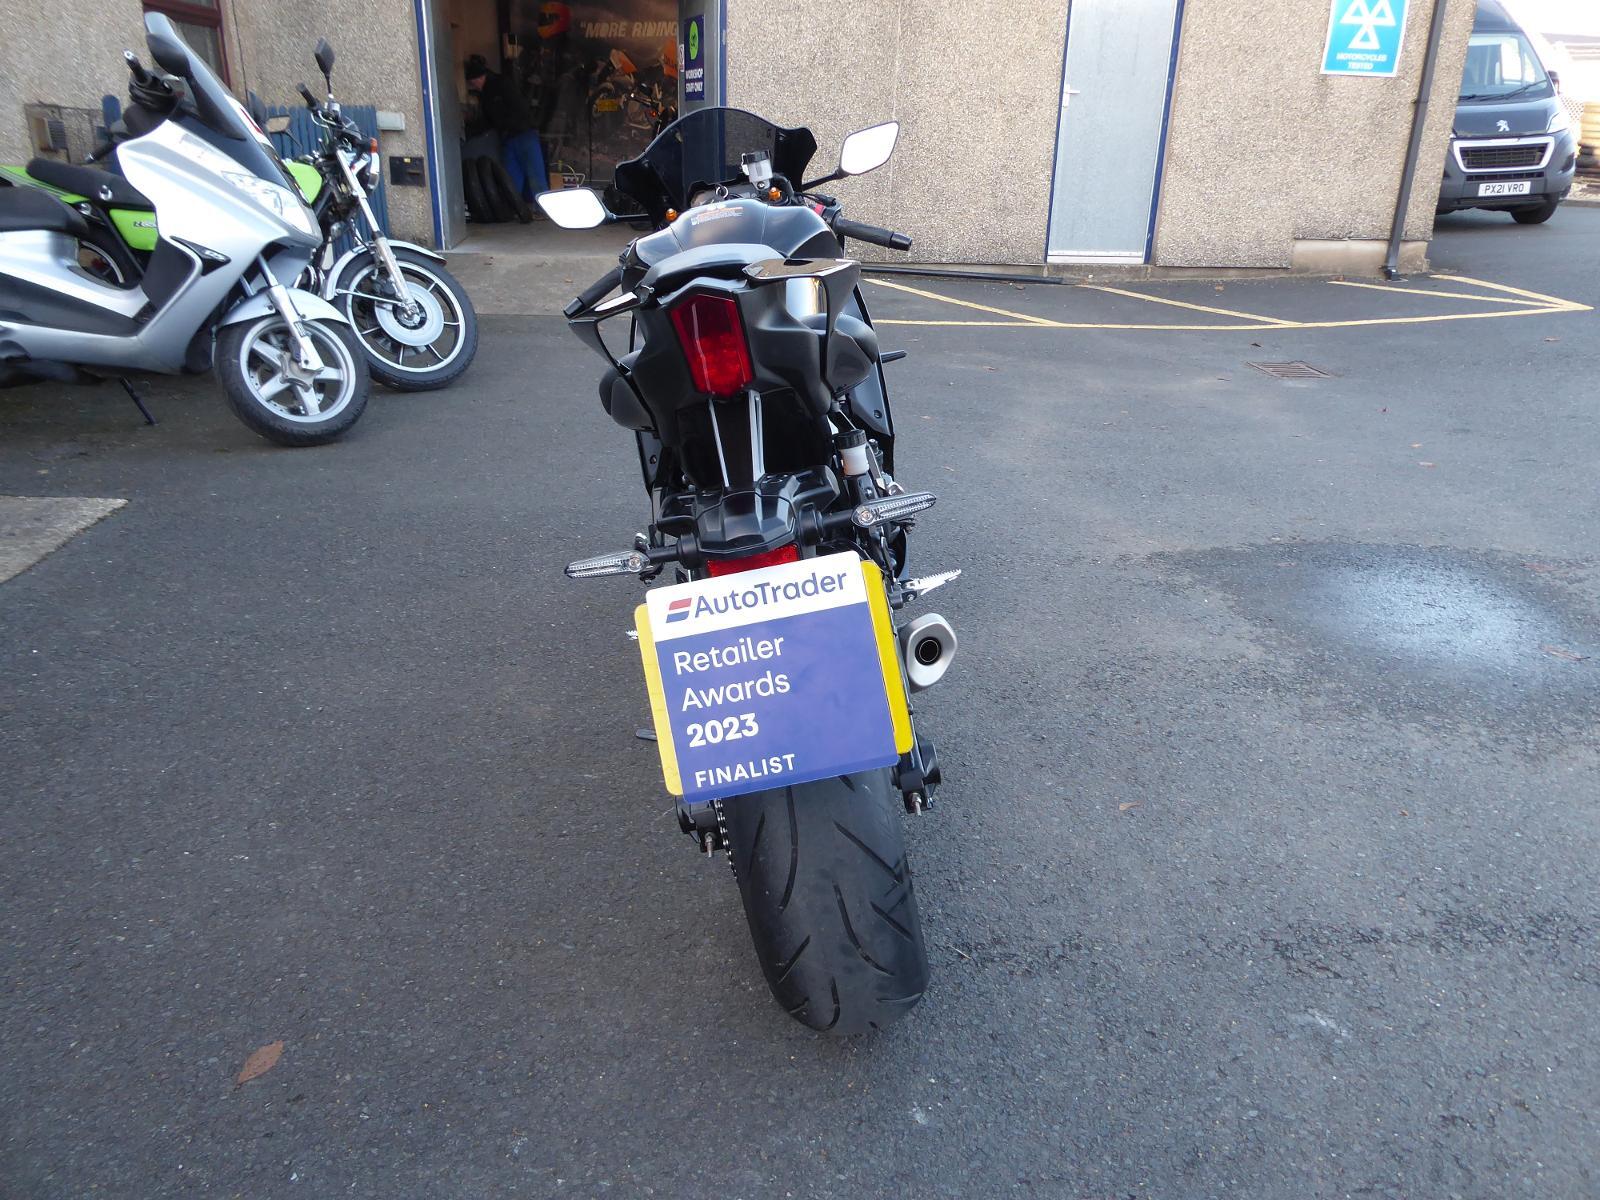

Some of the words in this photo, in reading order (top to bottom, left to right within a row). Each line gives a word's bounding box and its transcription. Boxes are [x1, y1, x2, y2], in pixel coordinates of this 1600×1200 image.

[1336, 53, 1388, 63] MOTORCYCLES
[1485, 184, 1505, 194] PX21
[694, 570, 848, 619] AutoTrader
[673, 636, 785, 675] Retailer
[681, 670, 791, 712] Awards
[686, 712, 760, 748] 2023
[694, 753, 796, 788] FINALIST
